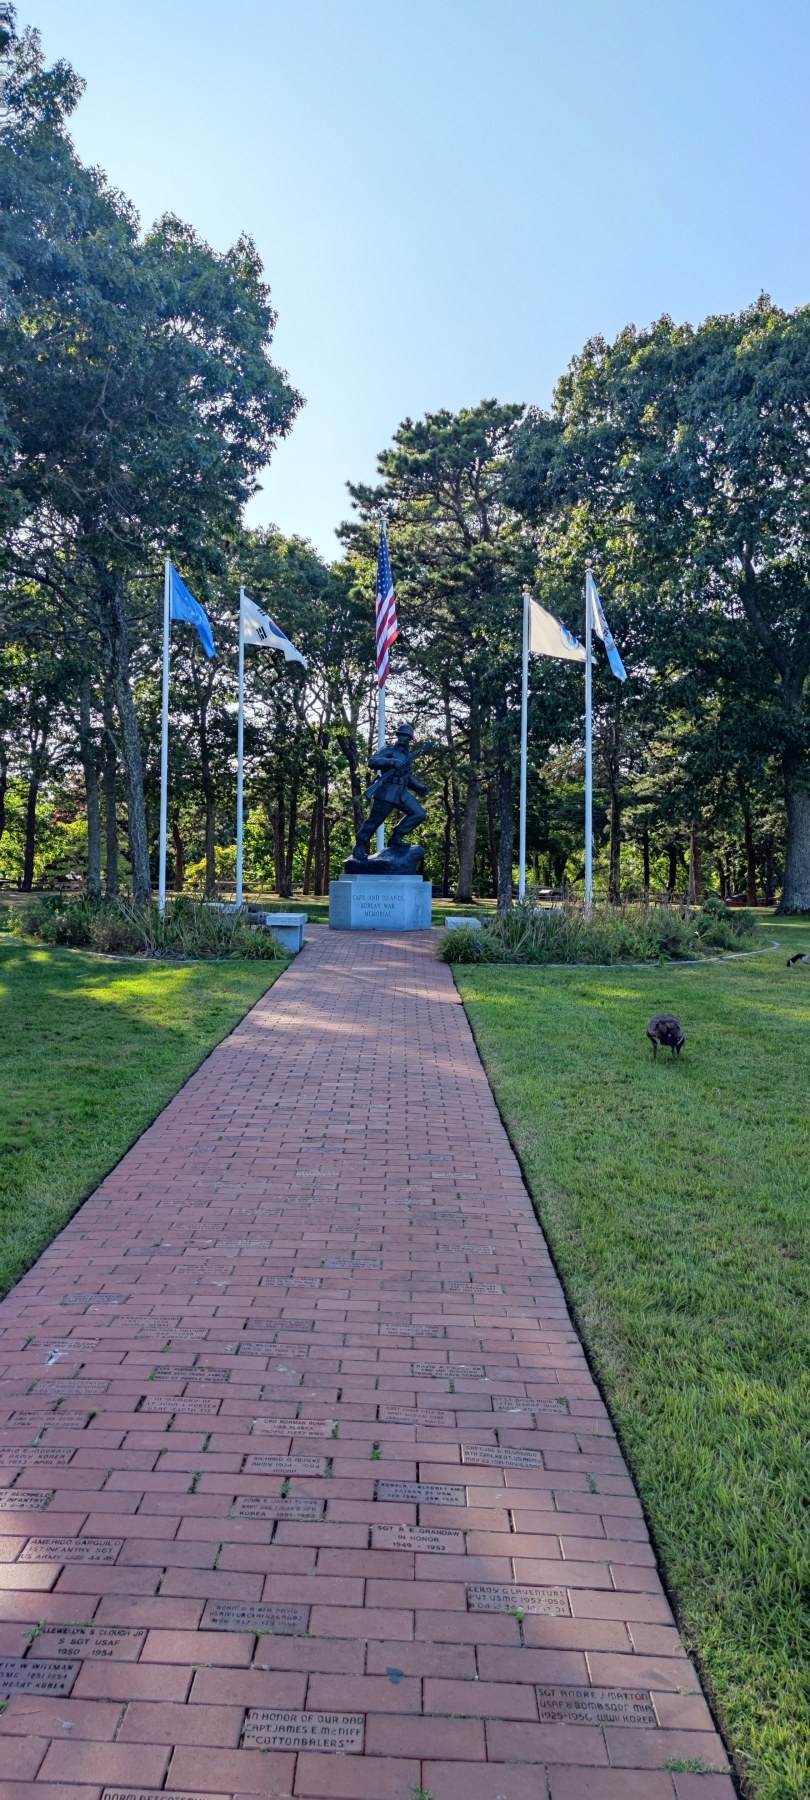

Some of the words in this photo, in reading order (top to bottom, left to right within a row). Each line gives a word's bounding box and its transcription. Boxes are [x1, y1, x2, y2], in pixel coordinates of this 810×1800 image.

[418, 1528, 460, 1536] GRANDAW
[490, 1595, 518, 1603] USMC
[99, 1628, 130, 1636] CLOUGH
[133, 1630, 144, 1638] JR
[538, 1688, 556, 1697] SGT
[560, 1690, 596, 1699] ANDRE
[608, 1692, 648, 1700] MATTON
[540, 1700, 564, 1709] USAF
[262, 1713, 298, 1722] HONOR
[300, 1714, 314, 1722] OF
[318, 1715, 338, 1724] OUR
[342, 1716, 364, 1725] DAD
[622, 1714, 656, 1724] KOREA
